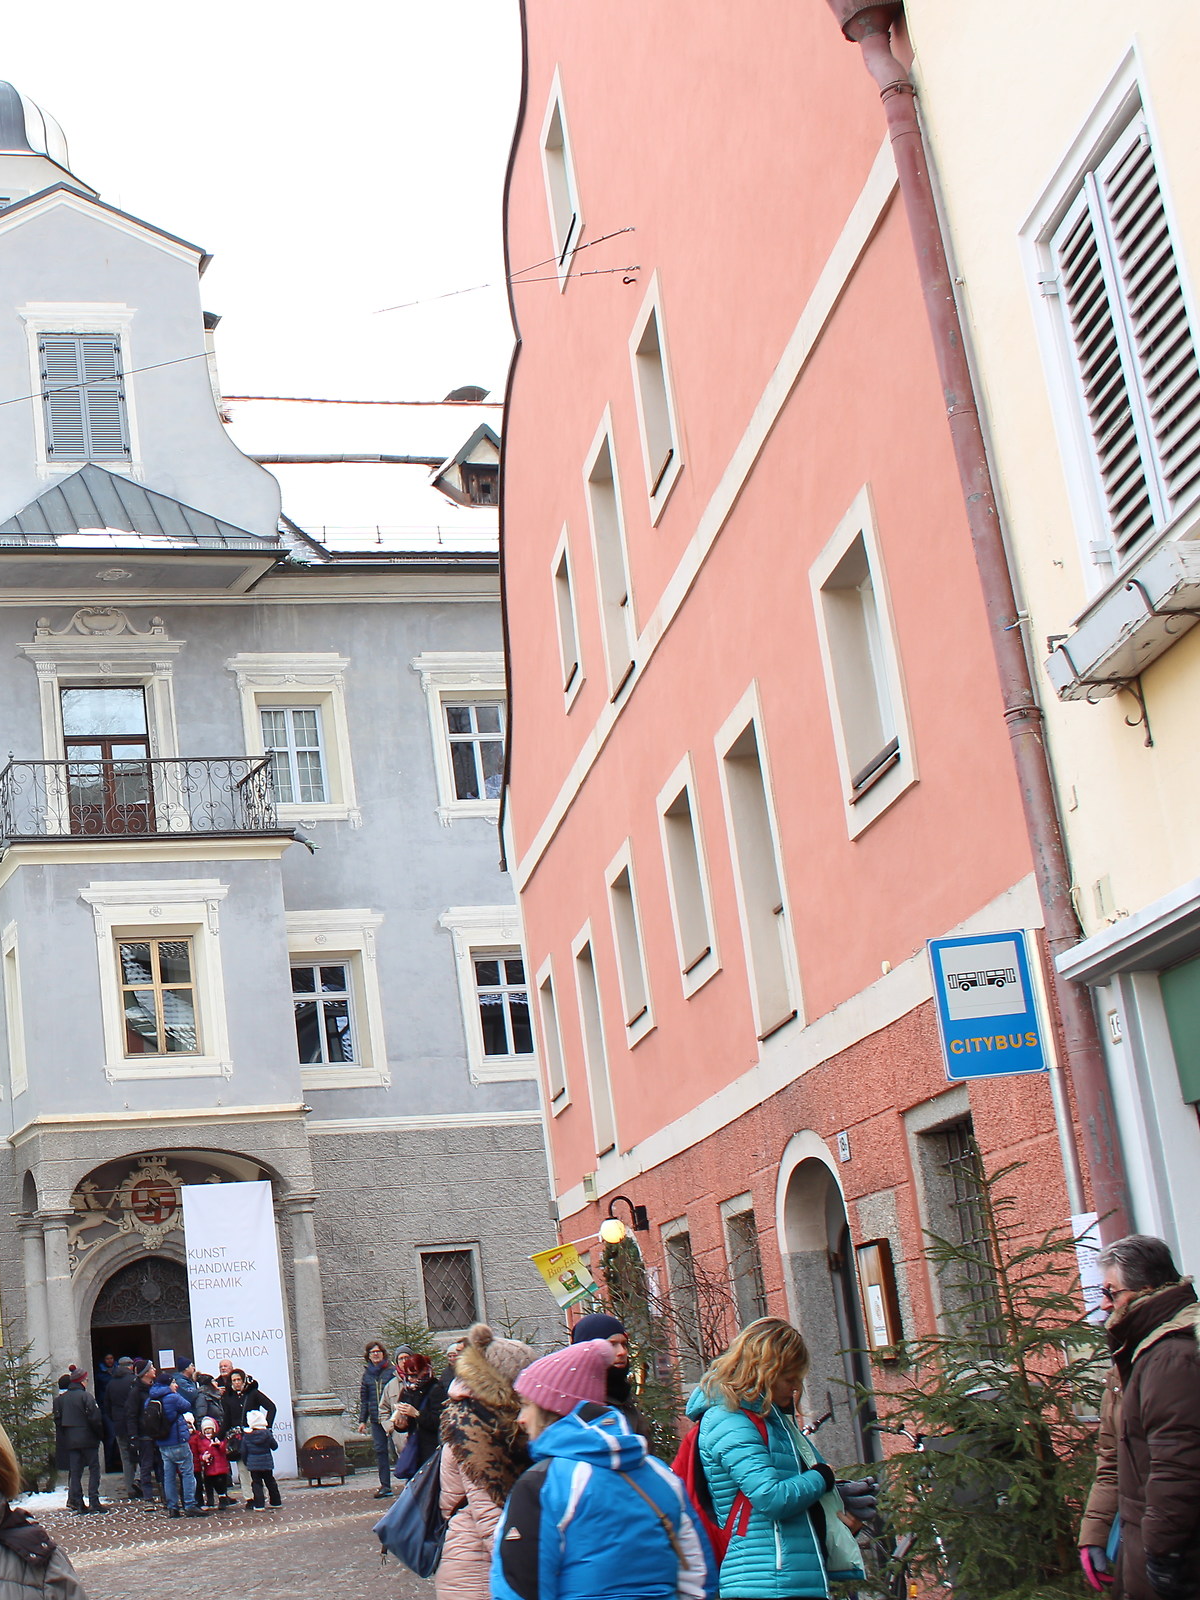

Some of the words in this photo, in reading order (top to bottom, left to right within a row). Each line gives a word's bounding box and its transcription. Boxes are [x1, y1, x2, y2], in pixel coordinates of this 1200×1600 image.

[950, 1031, 1038, 1054] CITYBUS
[187, 1246, 227, 1260] KUNST
[189, 1261, 257, 1275] HANDWERK
[190, 1277, 243, 1290] KERAMIK
[204, 1316, 235, 1329] ARTE
[205, 1328, 284, 1345] ARTIGIANATO
[207, 1345, 269, 1360] CERAMICA
[273, 1421, 292, 1431] ACH
